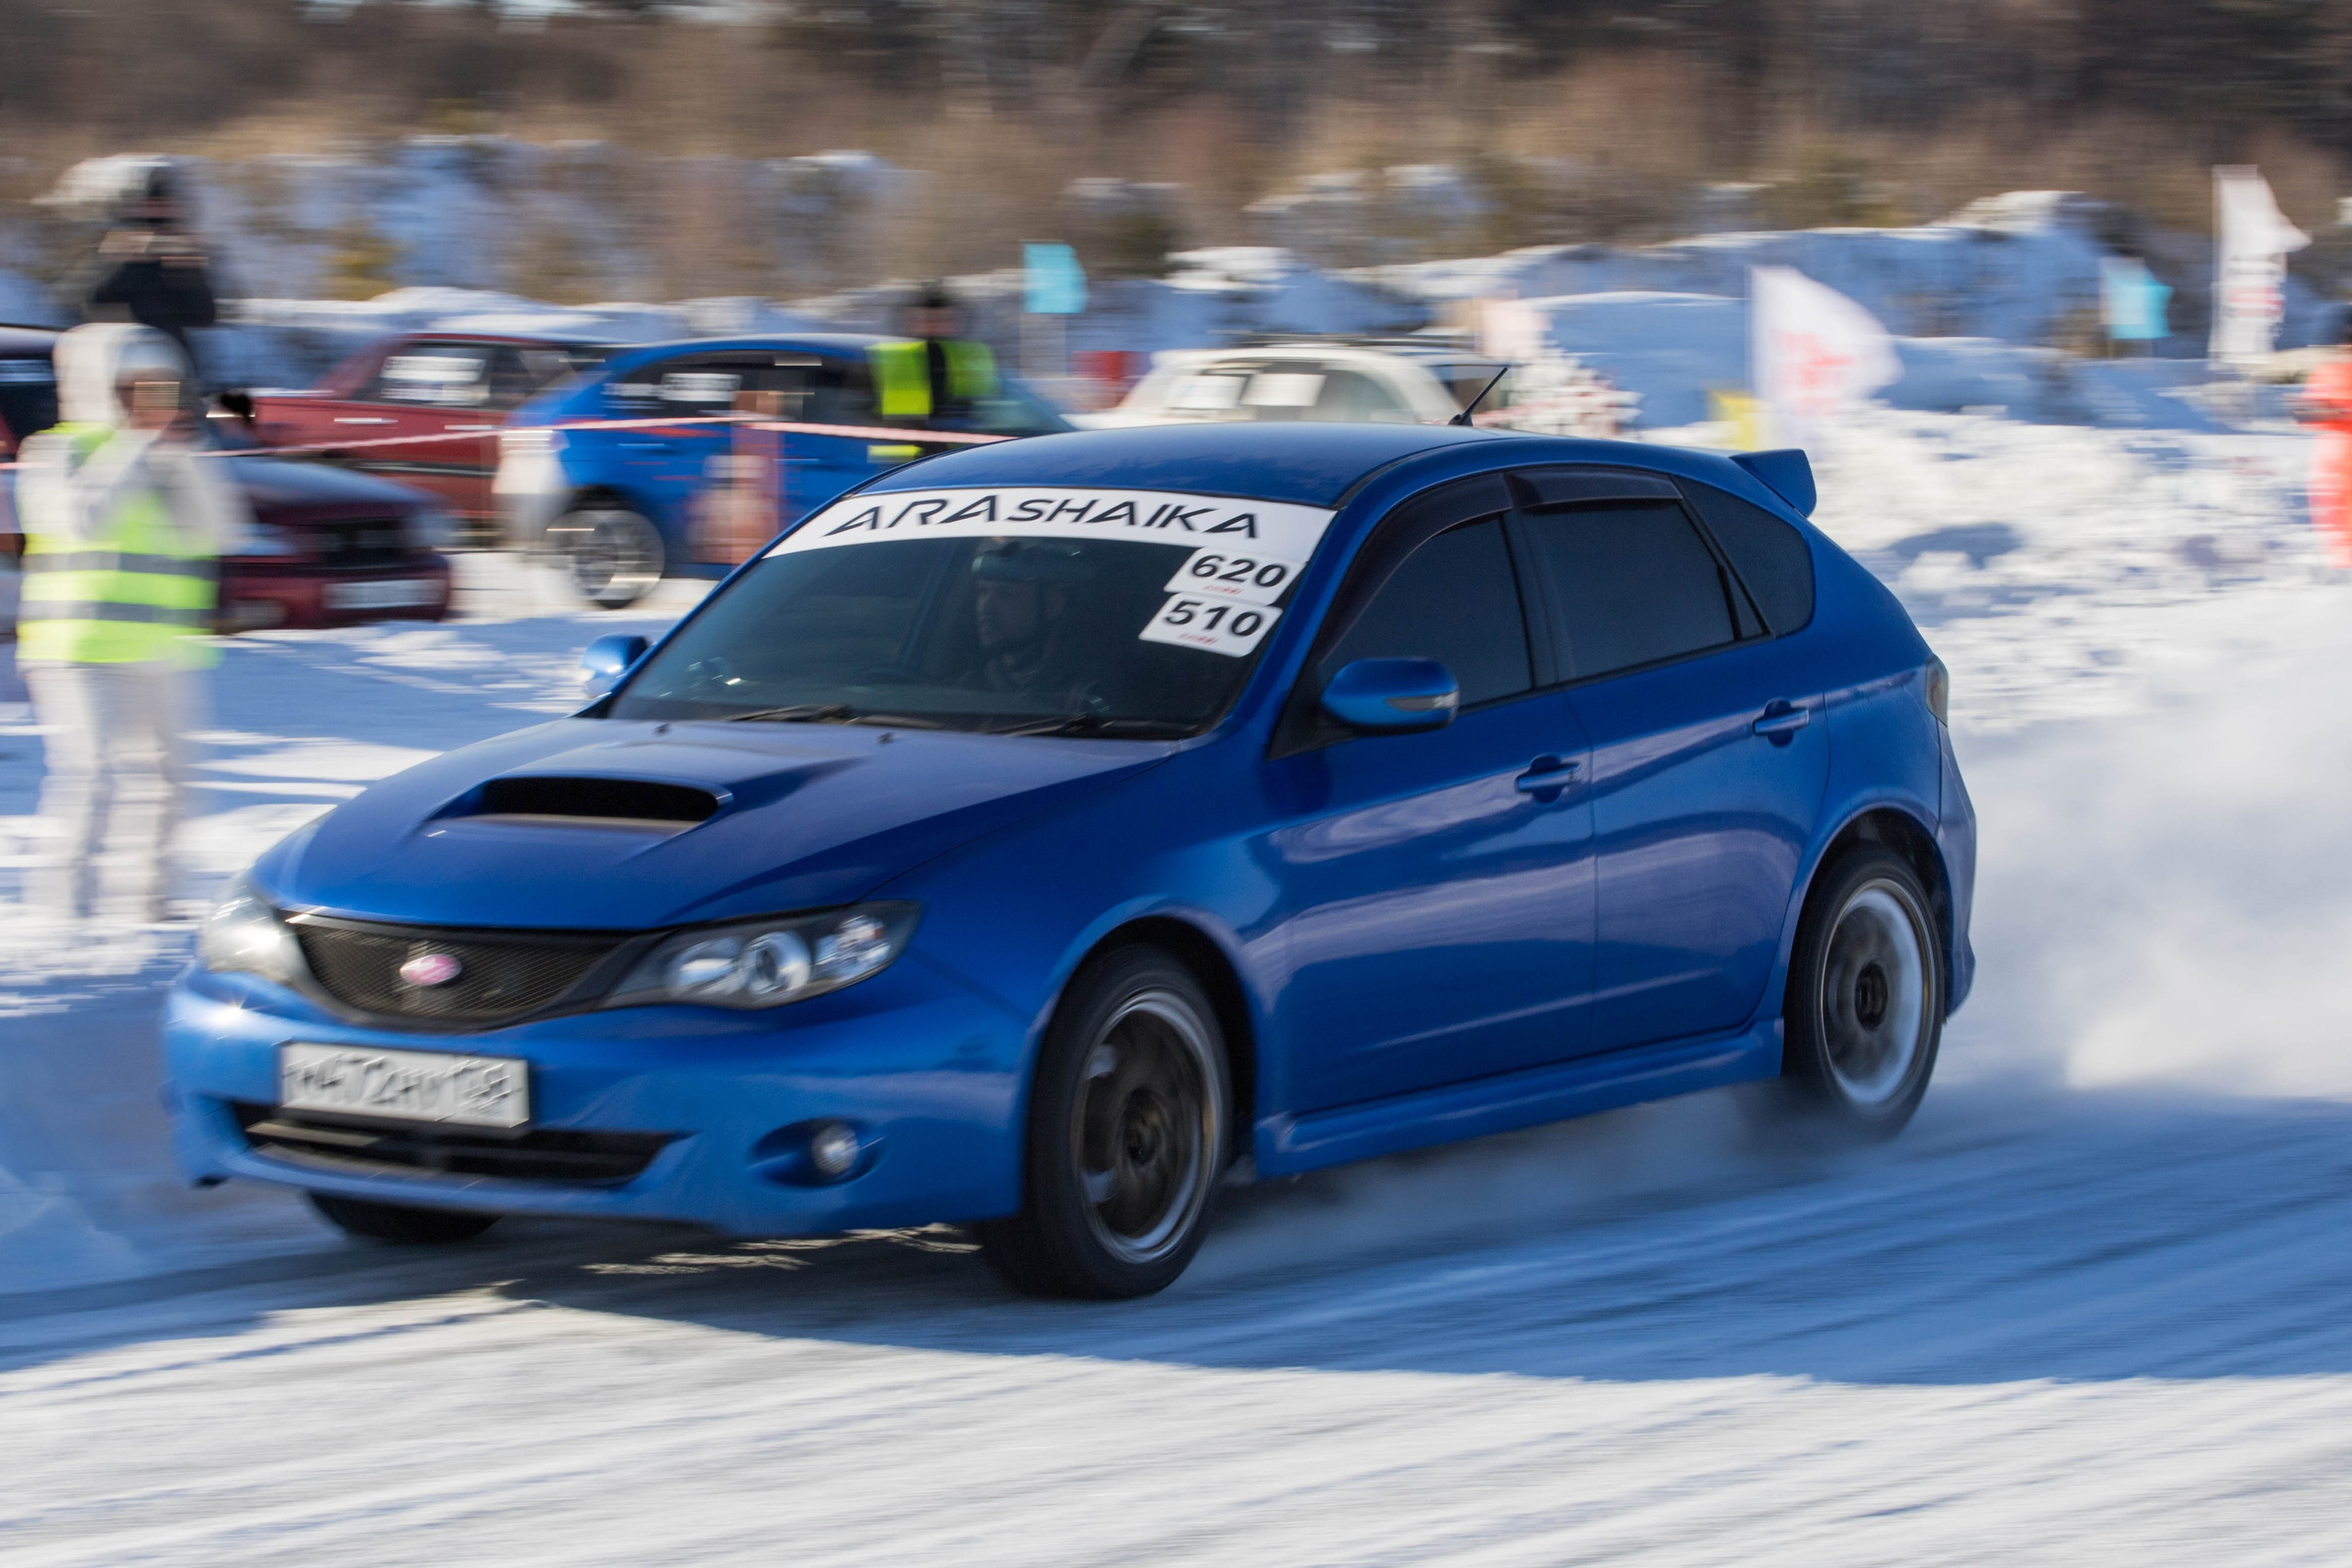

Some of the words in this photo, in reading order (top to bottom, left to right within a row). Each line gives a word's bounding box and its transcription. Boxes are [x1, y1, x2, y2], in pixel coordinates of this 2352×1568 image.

[823, 494, 1259, 539] ARASHAIKA
[1192, 555, 1287, 587] 620
[1165, 601, 1262, 637] 510
